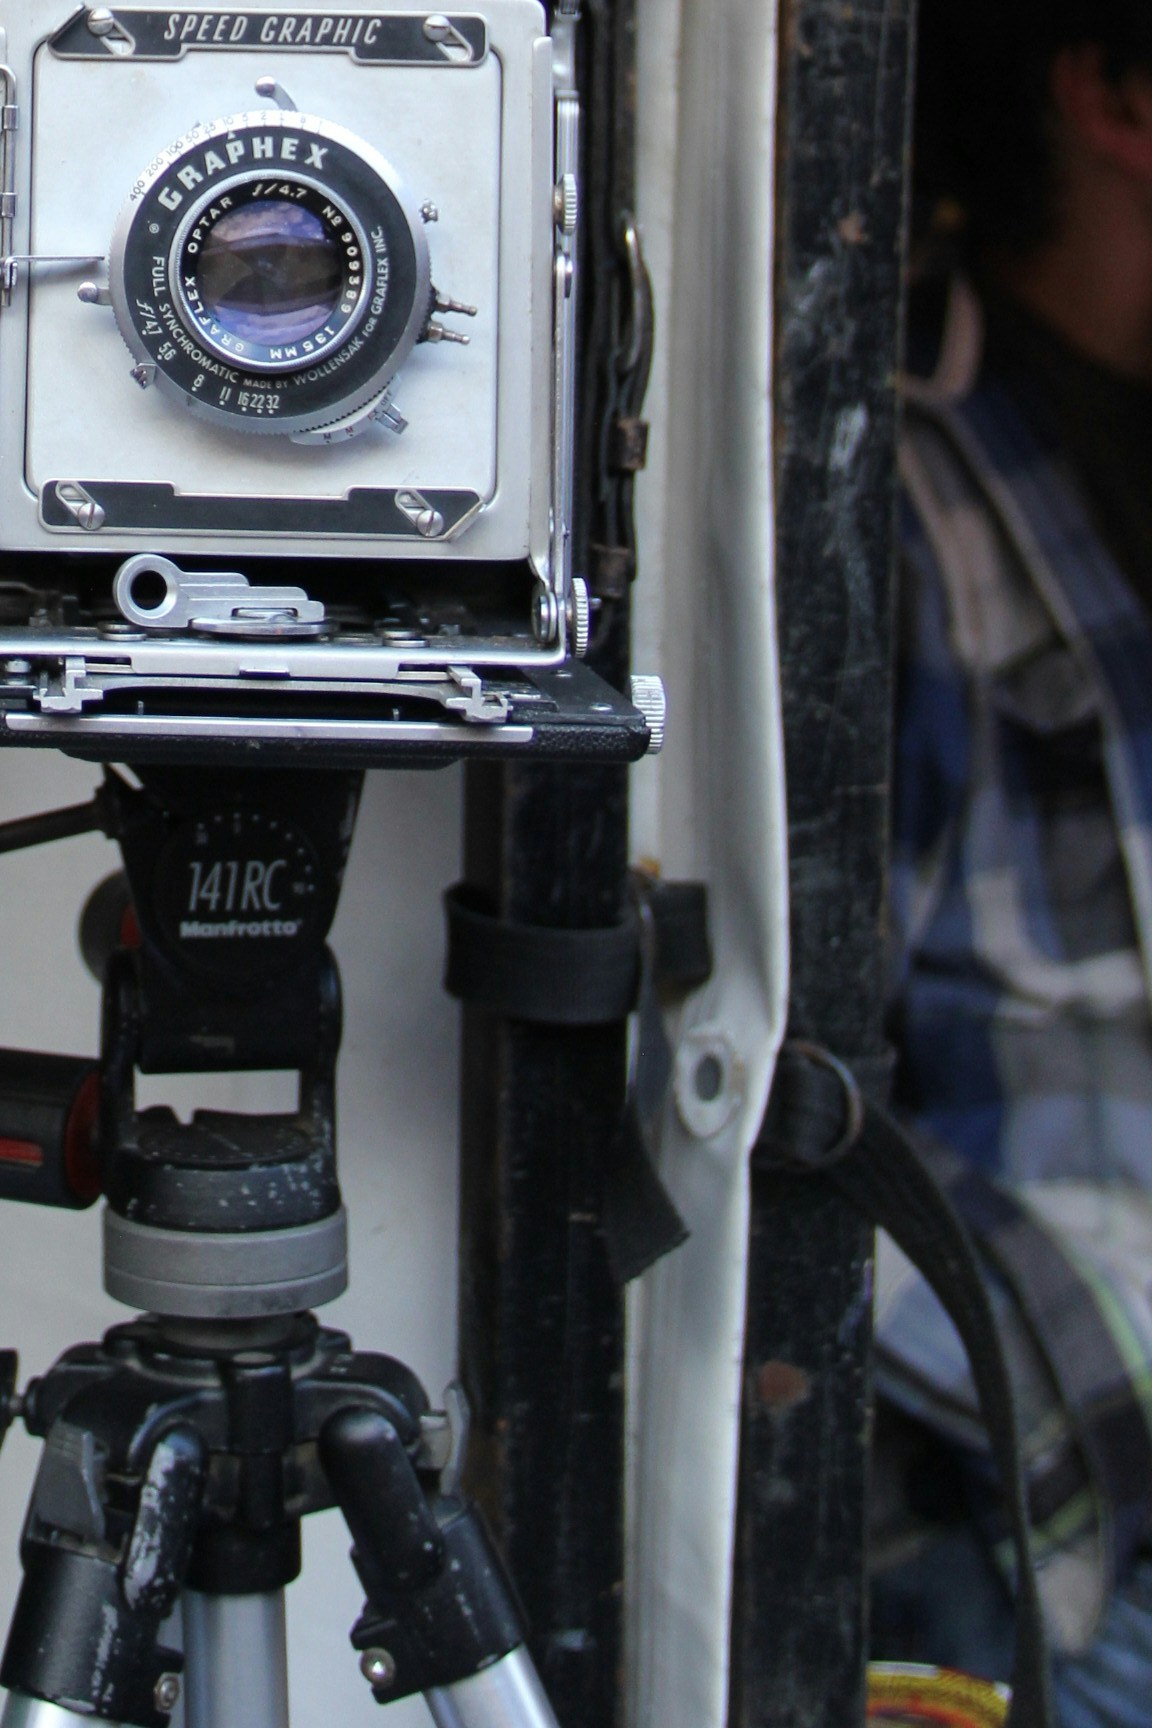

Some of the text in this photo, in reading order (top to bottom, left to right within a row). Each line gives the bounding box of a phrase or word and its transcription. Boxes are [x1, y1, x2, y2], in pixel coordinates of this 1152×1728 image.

[164, 13, 382, 44] SPEED GRAPHIC
[129, 180, 146, 202] 400
[146, 157, 164, 177] 200
[166, 140, 183, 157] 100
[158, 136, 328, 211] GRAPHEX
[188, 197, 232, 253] OPTAR
[370, 226, 387, 253] INC.
[151, 256, 166, 297] FULL
[340, 232, 360, 313] 909389
[370, 257, 389, 315] GRAFLEX
[184, 276, 245, 352] GRAFLEX
[362, 317, 378, 338] FOR
[159, 303, 240, 383] SYNCHROMATIC
[293, 336, 364, 386] WOLLENSAK
[193, 374, 205, 387] 8
[238, 391, 250, 406] 16
[250, 393, 265, 408] 22
[266, 395, 280, 409] 32
[243, 378, 272, 389] MADE
[187, 859, 286, 912] 141RC
[180, 920, 299, 938] Manfrotto
